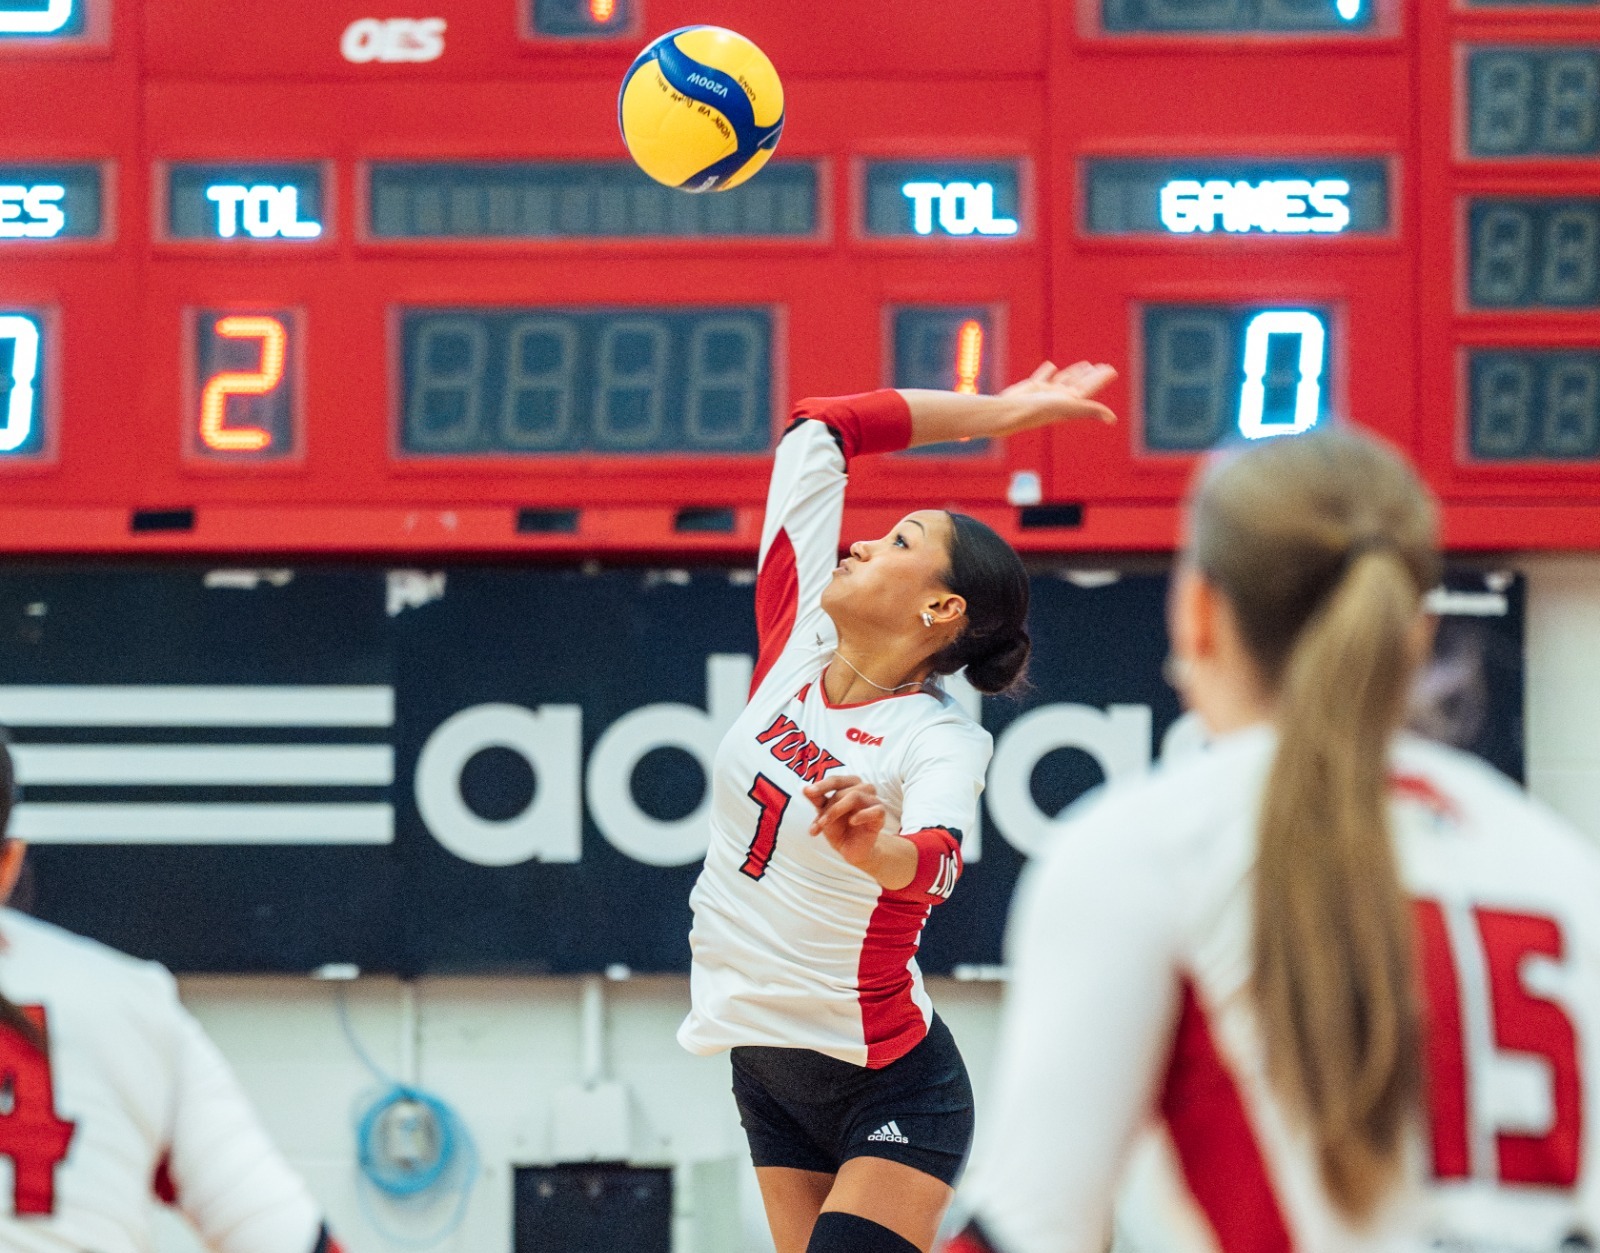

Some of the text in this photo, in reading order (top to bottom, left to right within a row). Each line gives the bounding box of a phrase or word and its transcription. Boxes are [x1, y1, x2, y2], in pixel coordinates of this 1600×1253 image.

[341, 18, 447, 62] OES
[687, 73, 728, 98] V200W
[206, 184, 323, 239] TOL
[903, 182, 1018, 235] TOL
[1160, 180, 1350, 233] GAMES
[200, 315, 286, 450] 2
[1238, 311, 1324, 440] 0
[755, 713, 845, 784] YORK
[846, 727, 885, 747] OVA
[1408, 897, 1582, 1188] 15
[867, 1133, 909, 1144] adidas
